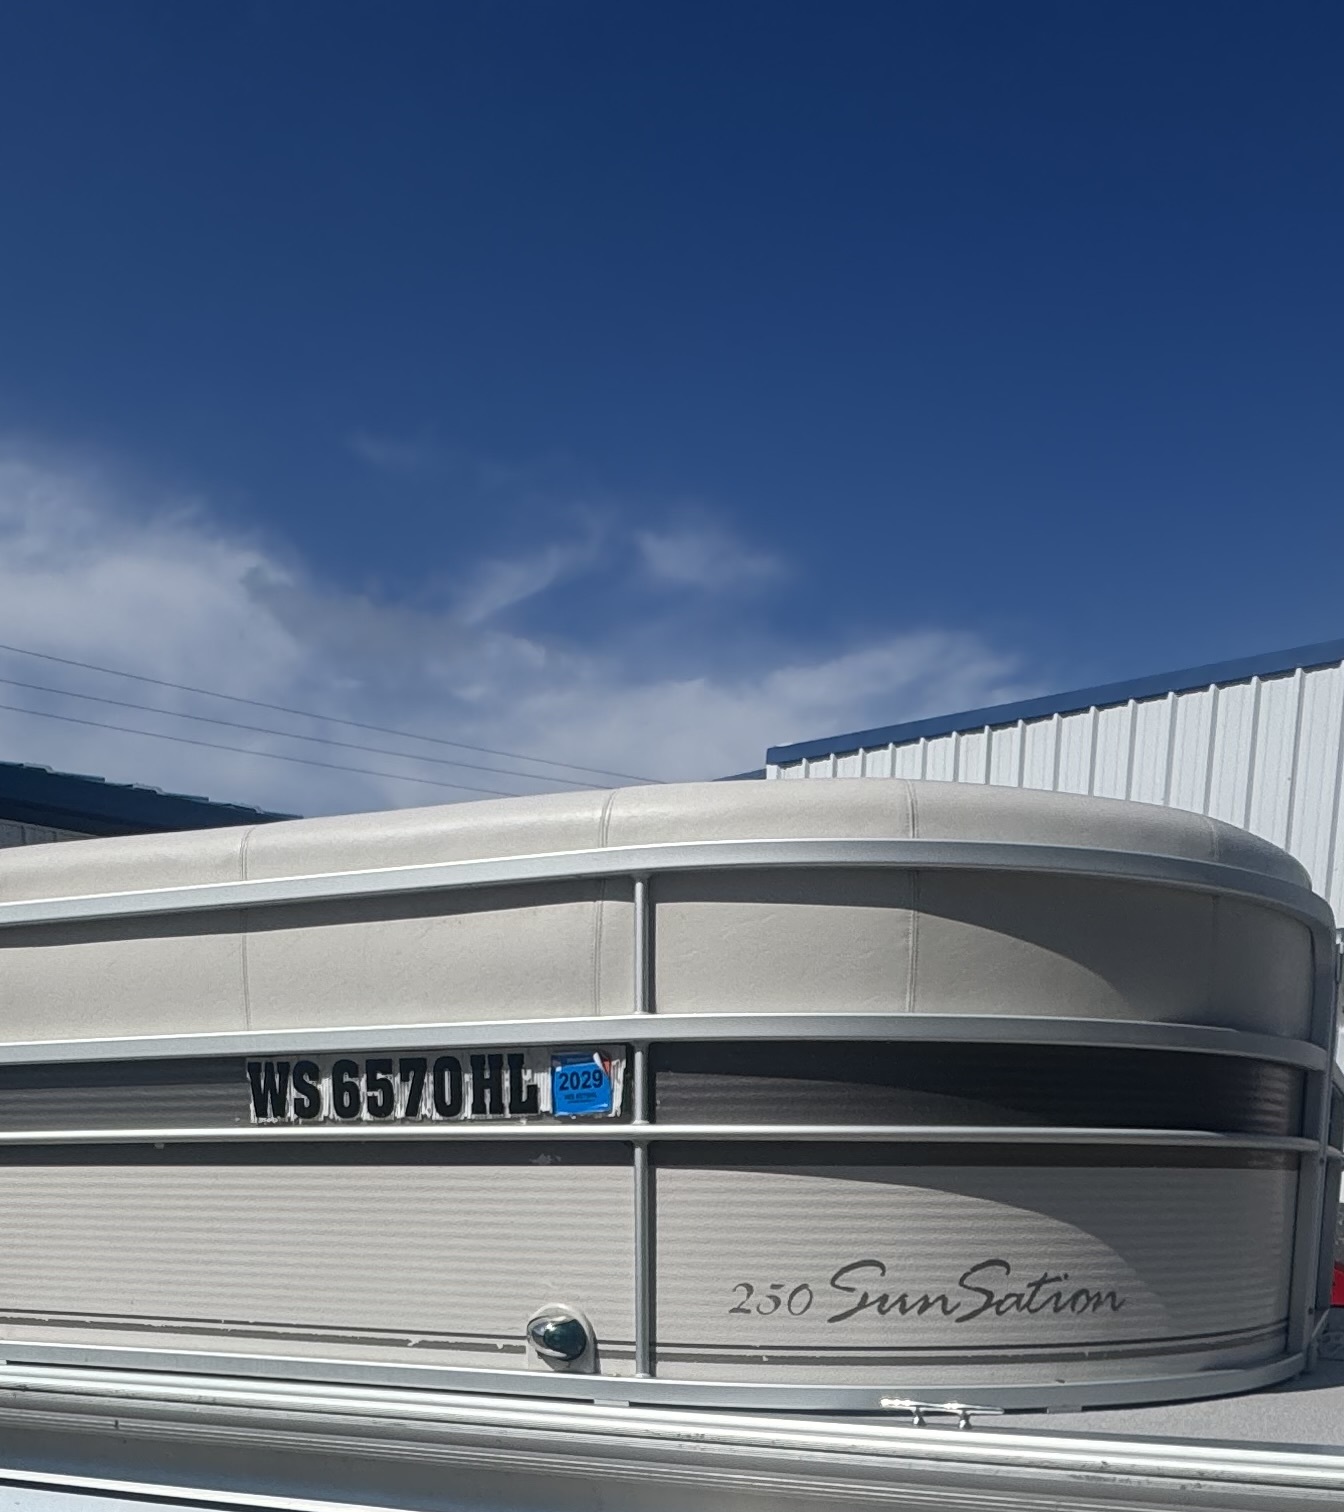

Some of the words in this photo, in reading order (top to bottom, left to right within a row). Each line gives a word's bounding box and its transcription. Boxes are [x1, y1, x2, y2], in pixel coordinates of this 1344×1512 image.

[247, 1060, 320, 1119] WS
[559, 1069, 604, 1091] 2029
[728, 1282, 815, 1317] 250
